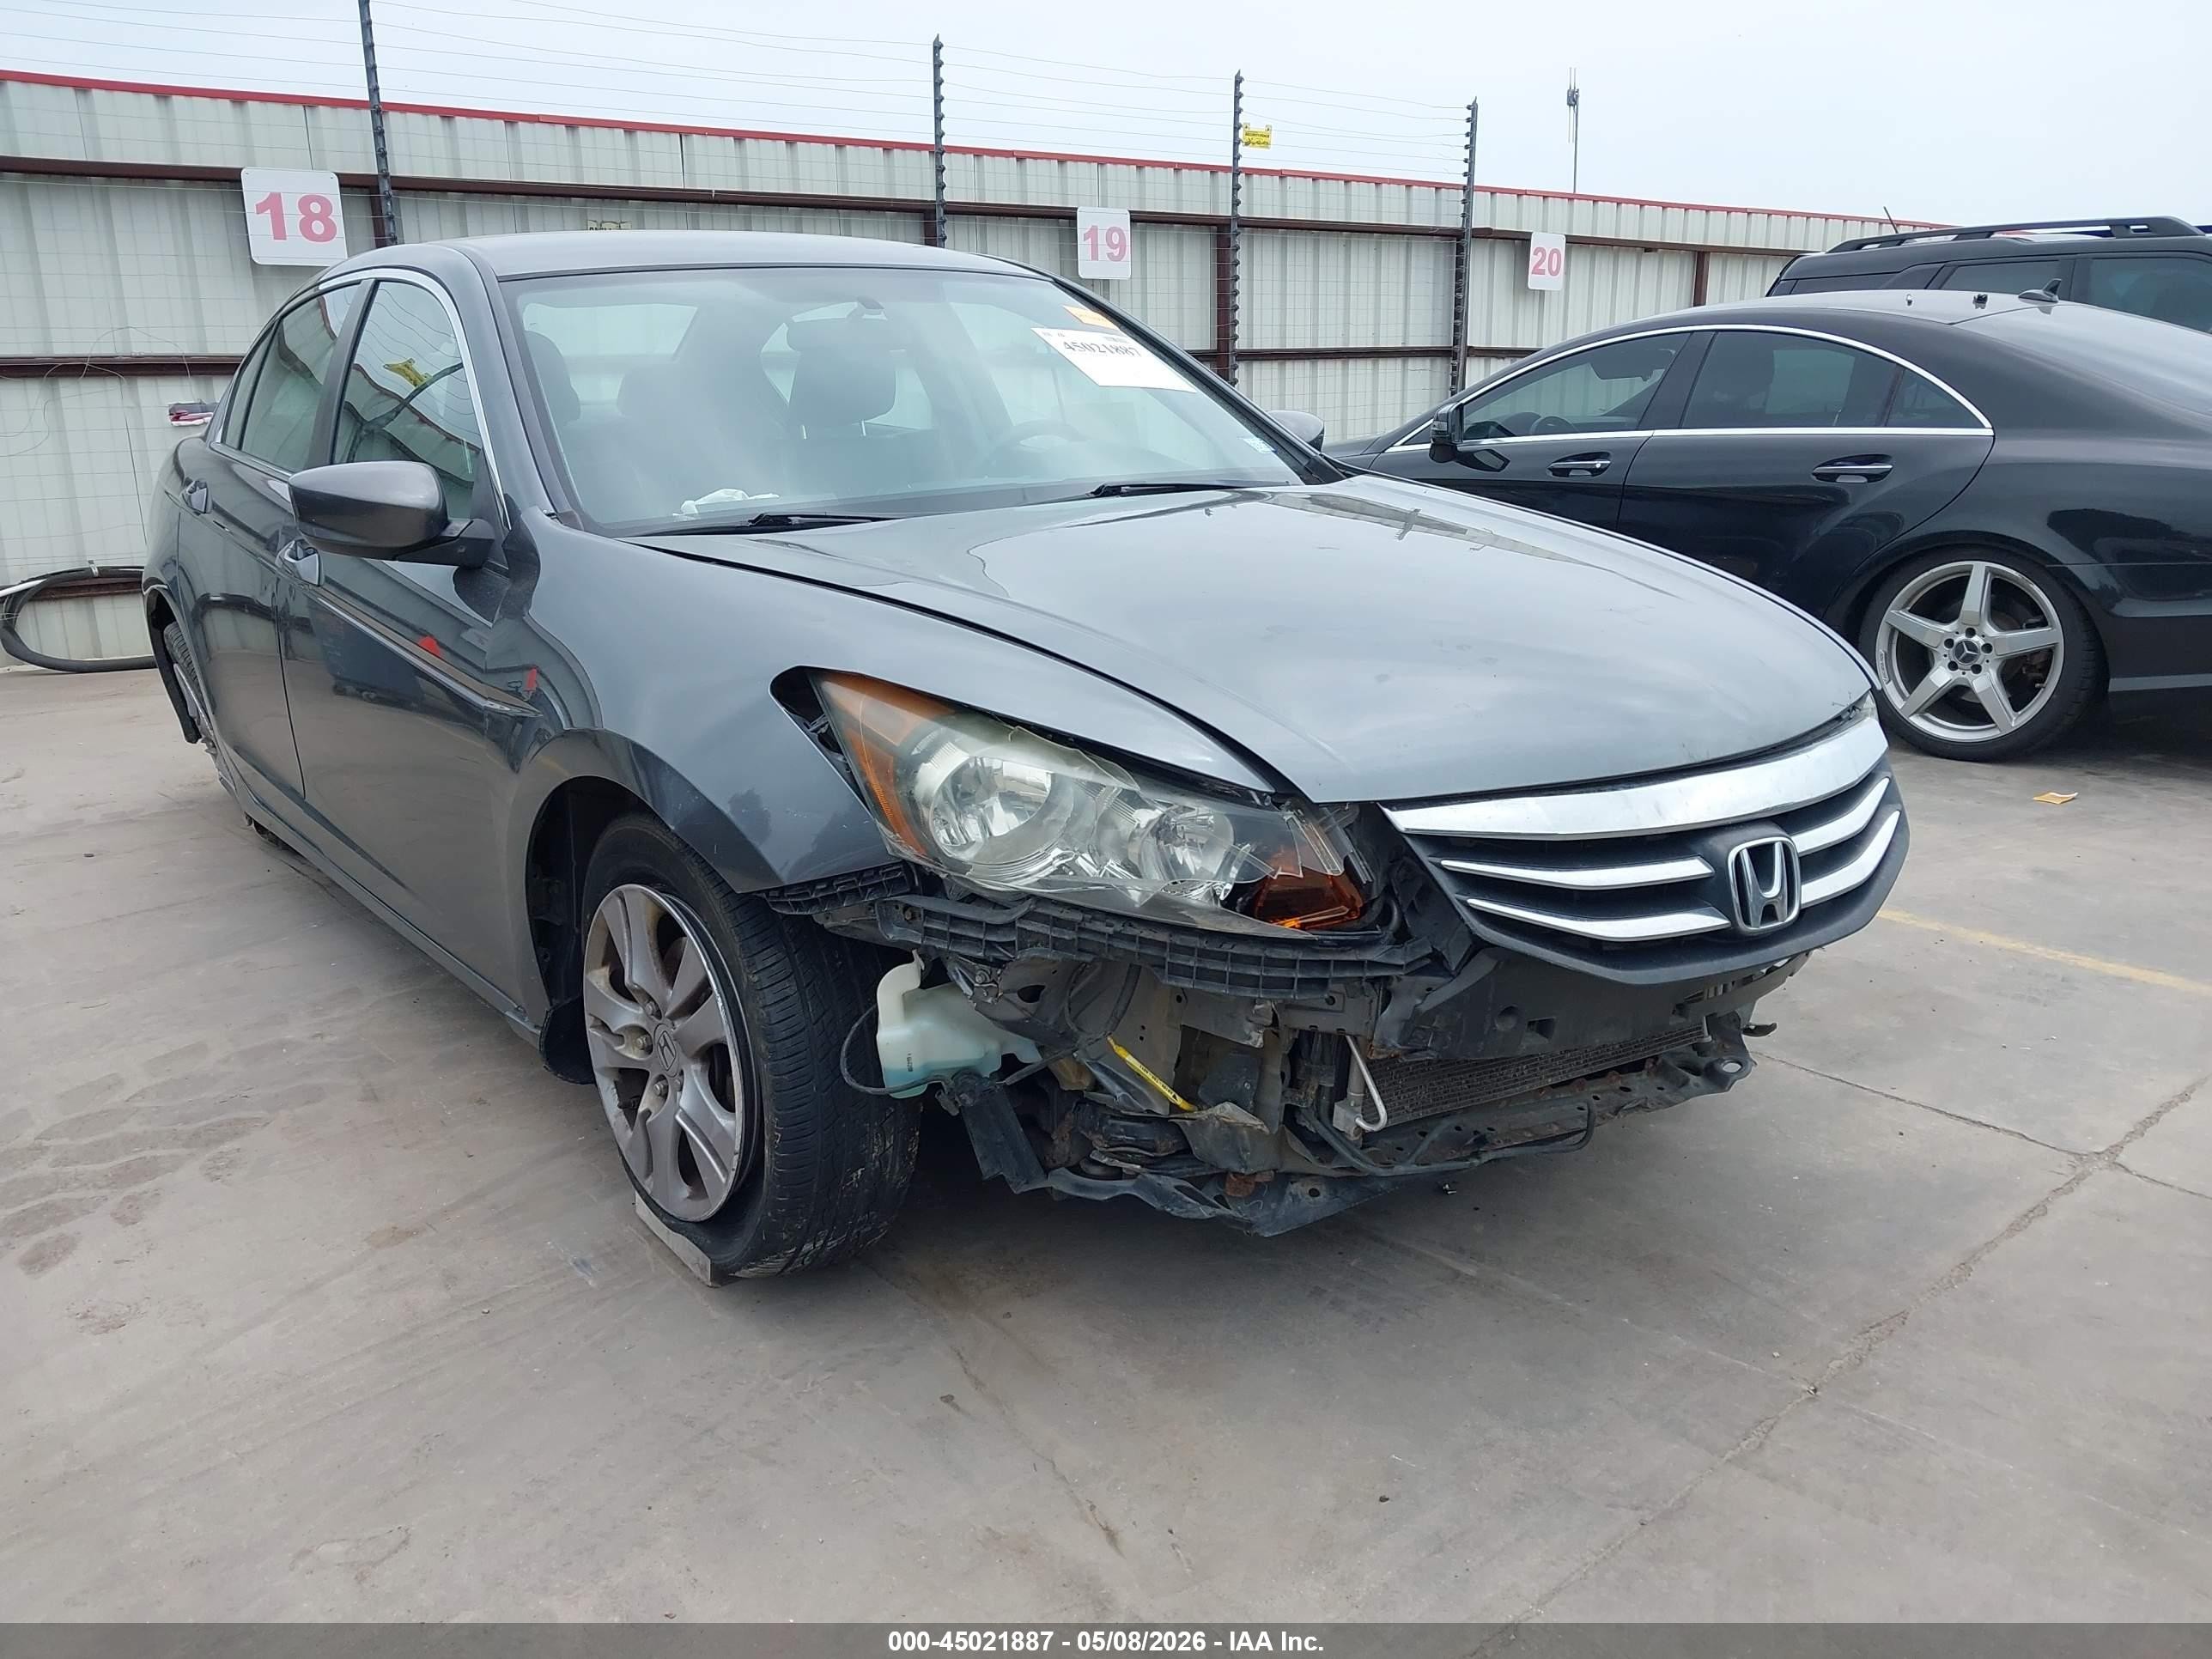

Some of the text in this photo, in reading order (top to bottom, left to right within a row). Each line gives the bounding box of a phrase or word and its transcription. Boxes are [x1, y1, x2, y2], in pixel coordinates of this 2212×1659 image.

[255, 191, 337, 242] 18
[1083, 225, 1127, 262] 19
[1531, 246, 1562, 276] 20
